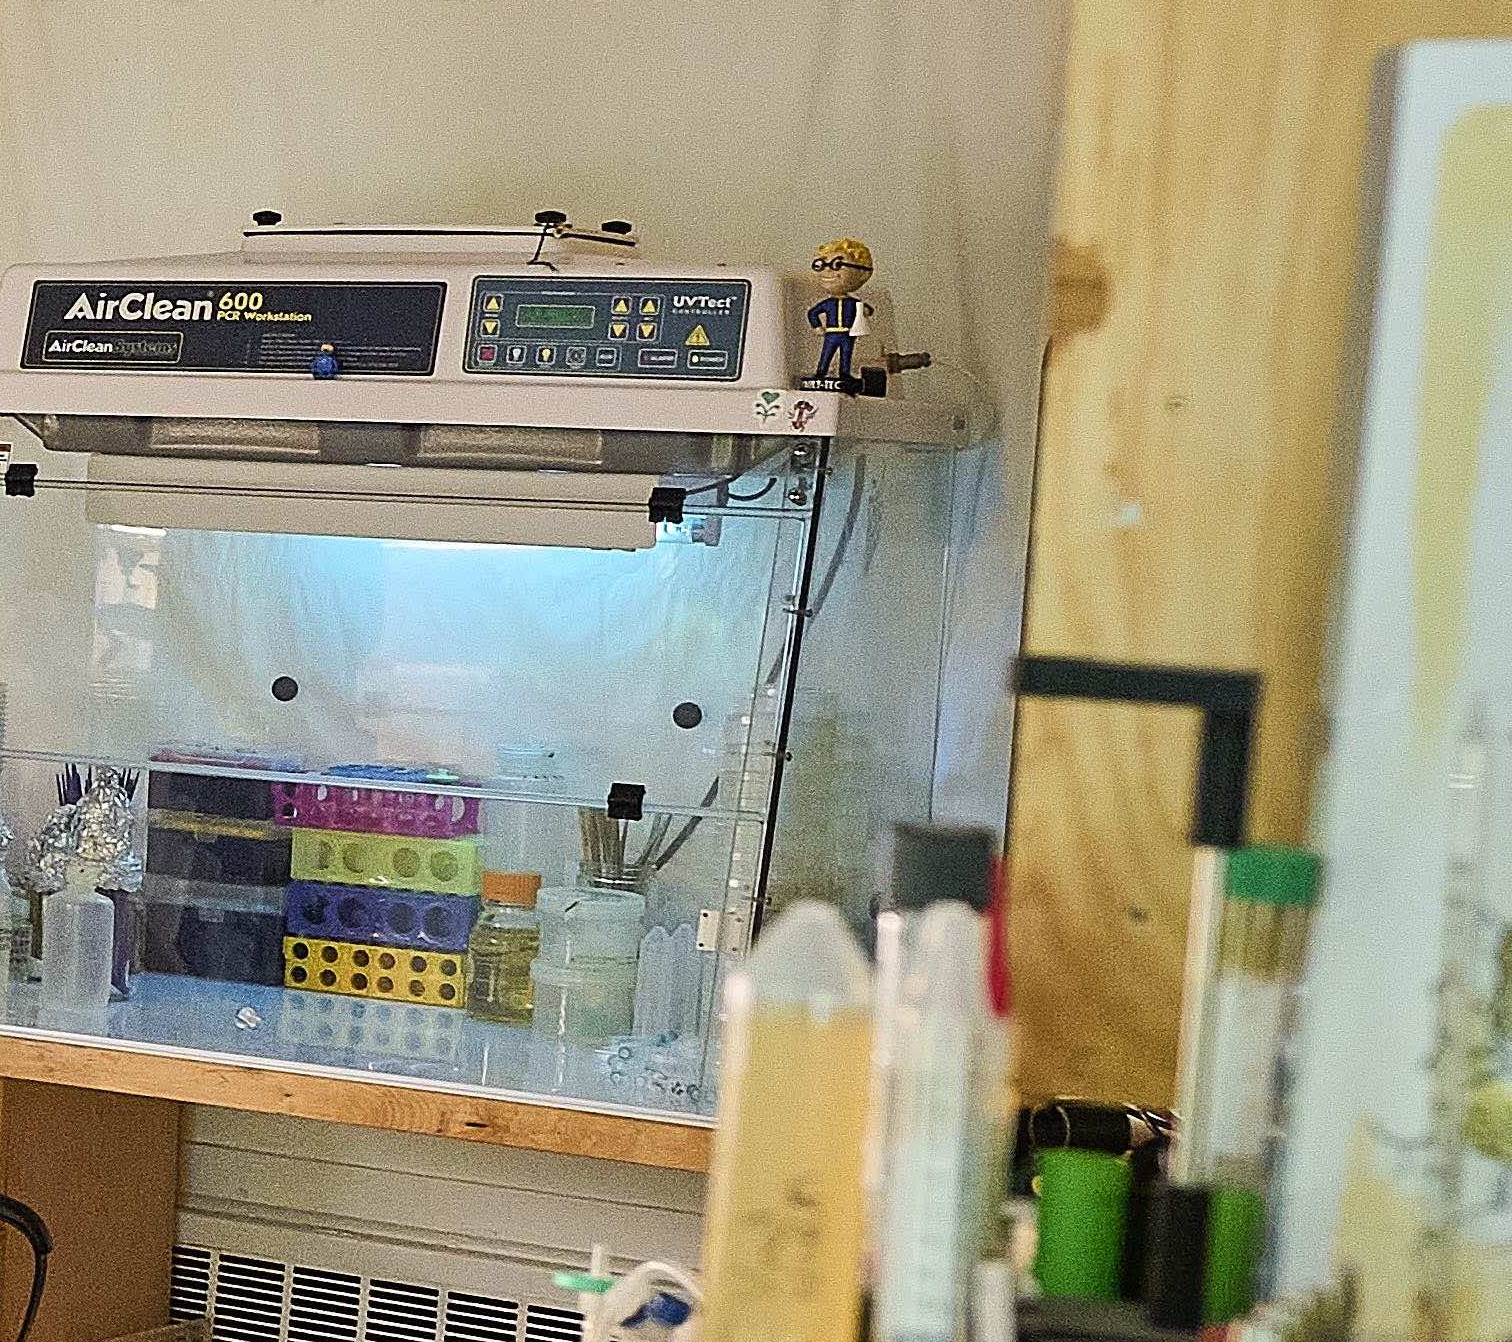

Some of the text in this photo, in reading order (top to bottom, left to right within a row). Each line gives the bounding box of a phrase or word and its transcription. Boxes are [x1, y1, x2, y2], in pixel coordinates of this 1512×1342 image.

[64, 292, 263, 321] AirClean 600
[672, 295, 732, 309] UVTect
[217, 311, 312, 322] PCR Workstation
[48, 339, 113, 353] AirClean
